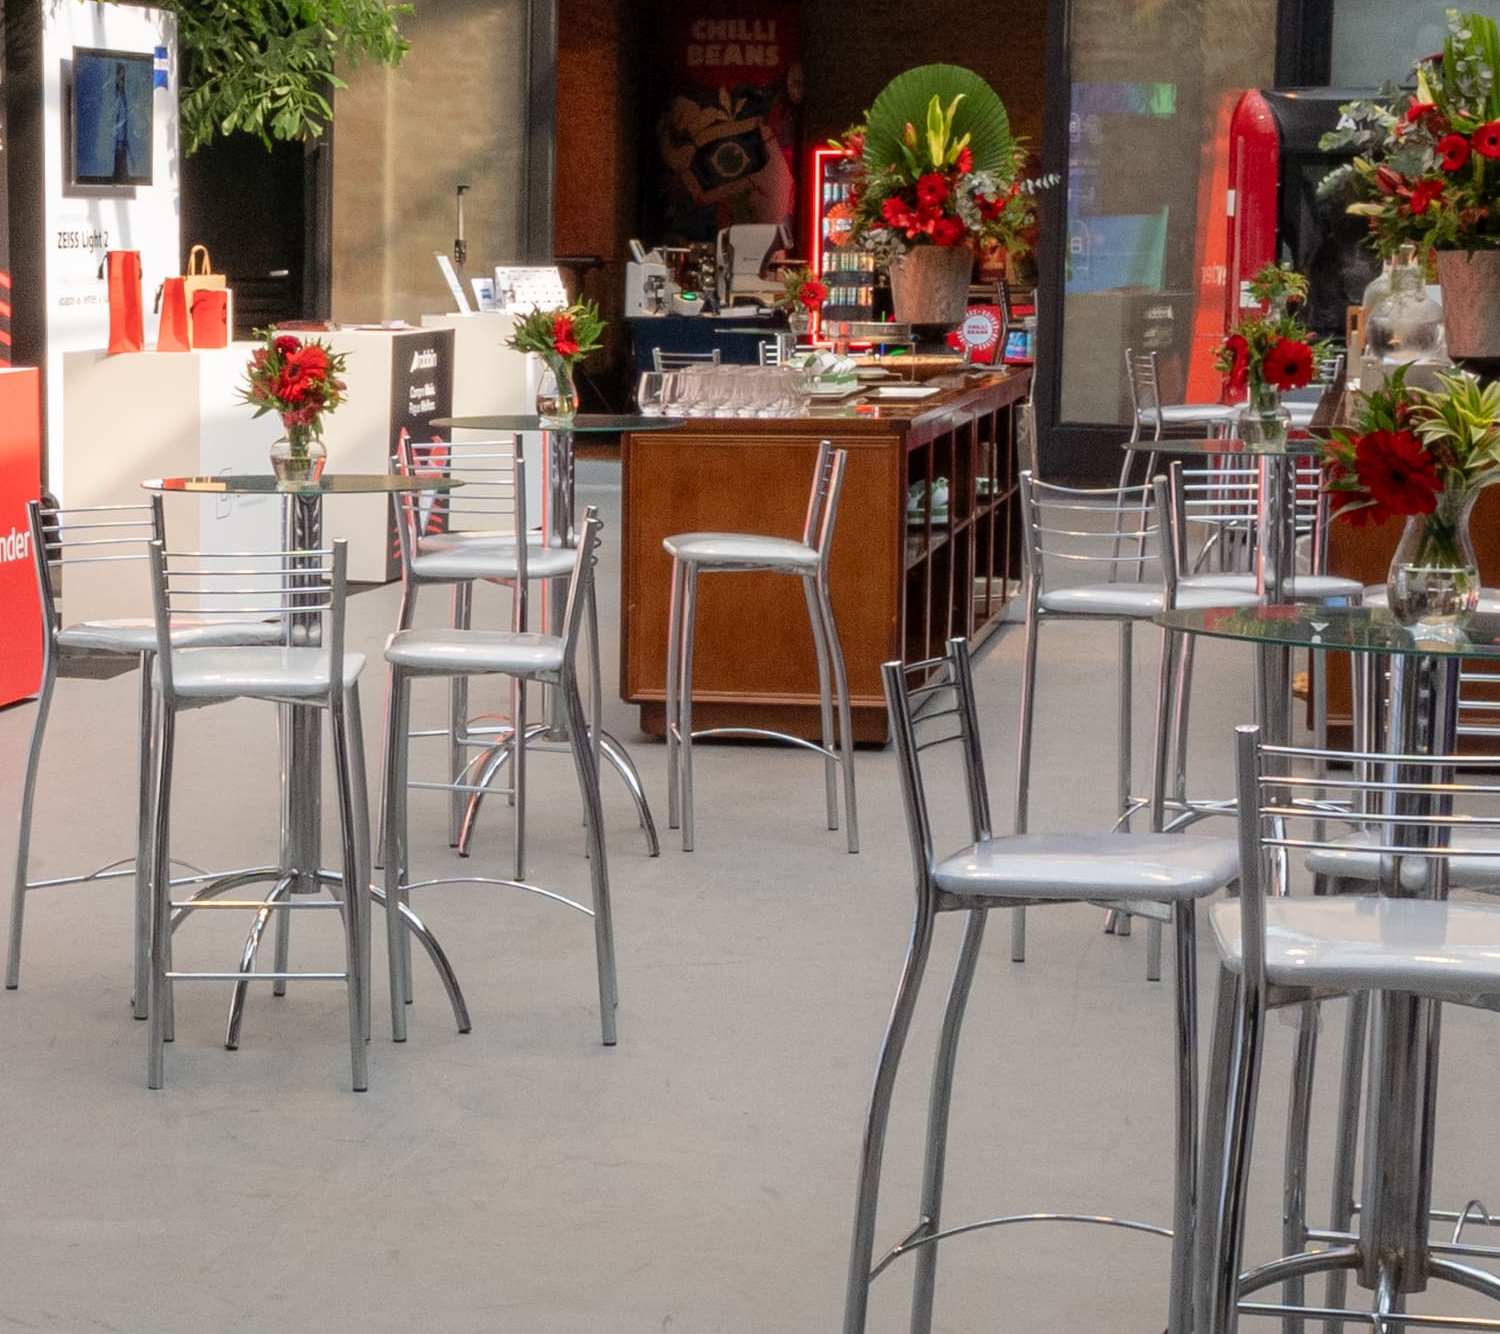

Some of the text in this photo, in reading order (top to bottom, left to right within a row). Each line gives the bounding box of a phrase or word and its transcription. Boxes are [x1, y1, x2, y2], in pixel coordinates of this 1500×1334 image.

[690, 18, 777, 41] CHILLI
[687, 43, 780, 67] BEANS
[57, 230, 80, 249] ZEISS
[81, 229, 102, 254] Light
